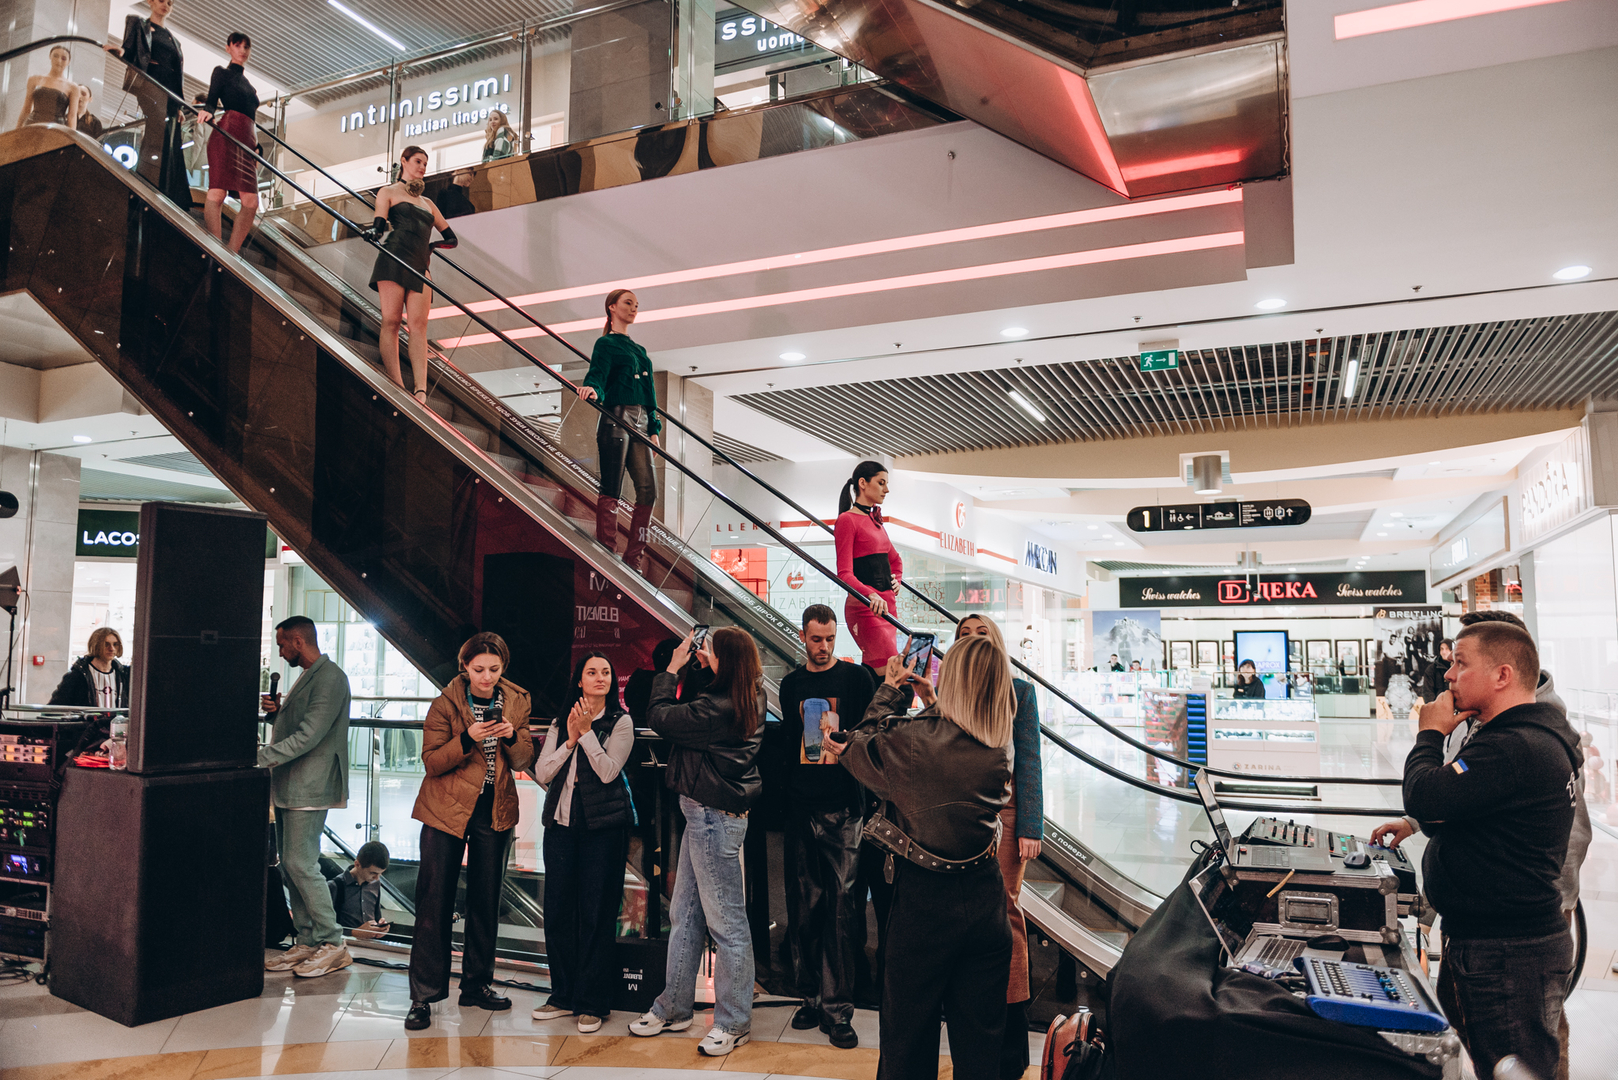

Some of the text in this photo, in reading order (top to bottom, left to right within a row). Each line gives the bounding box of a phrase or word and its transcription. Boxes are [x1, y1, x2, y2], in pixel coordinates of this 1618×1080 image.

[405, 116, 448, 138] Italian
[495, 405, 511, 418] ЩОБ
[509, 414, 526, 430] ЗУБИ
[524, 427, 548, 446] НІКОЛИ
[555, 451, 572, 465] БУЛИ
[617, 498, 634, 513] ЩОБ
[651, 525, 679, 547] БІЛЬШЕ
[1142, 510, 1150, 528] 1
[940, 531, 975, 557] ELIZABETH
[1167, 588, 1201, 600] watches
[1253, 581, 1318, 602] ДЕКА
[1365, 584, 1403, 596] watches
[736, 589, 755, 607] ЩОБ
[752, 601, 777, 625] ДІРОК
[1244, 763, 1282, 771] ZARINA
[1057, 837, 1087, 861] поверх
